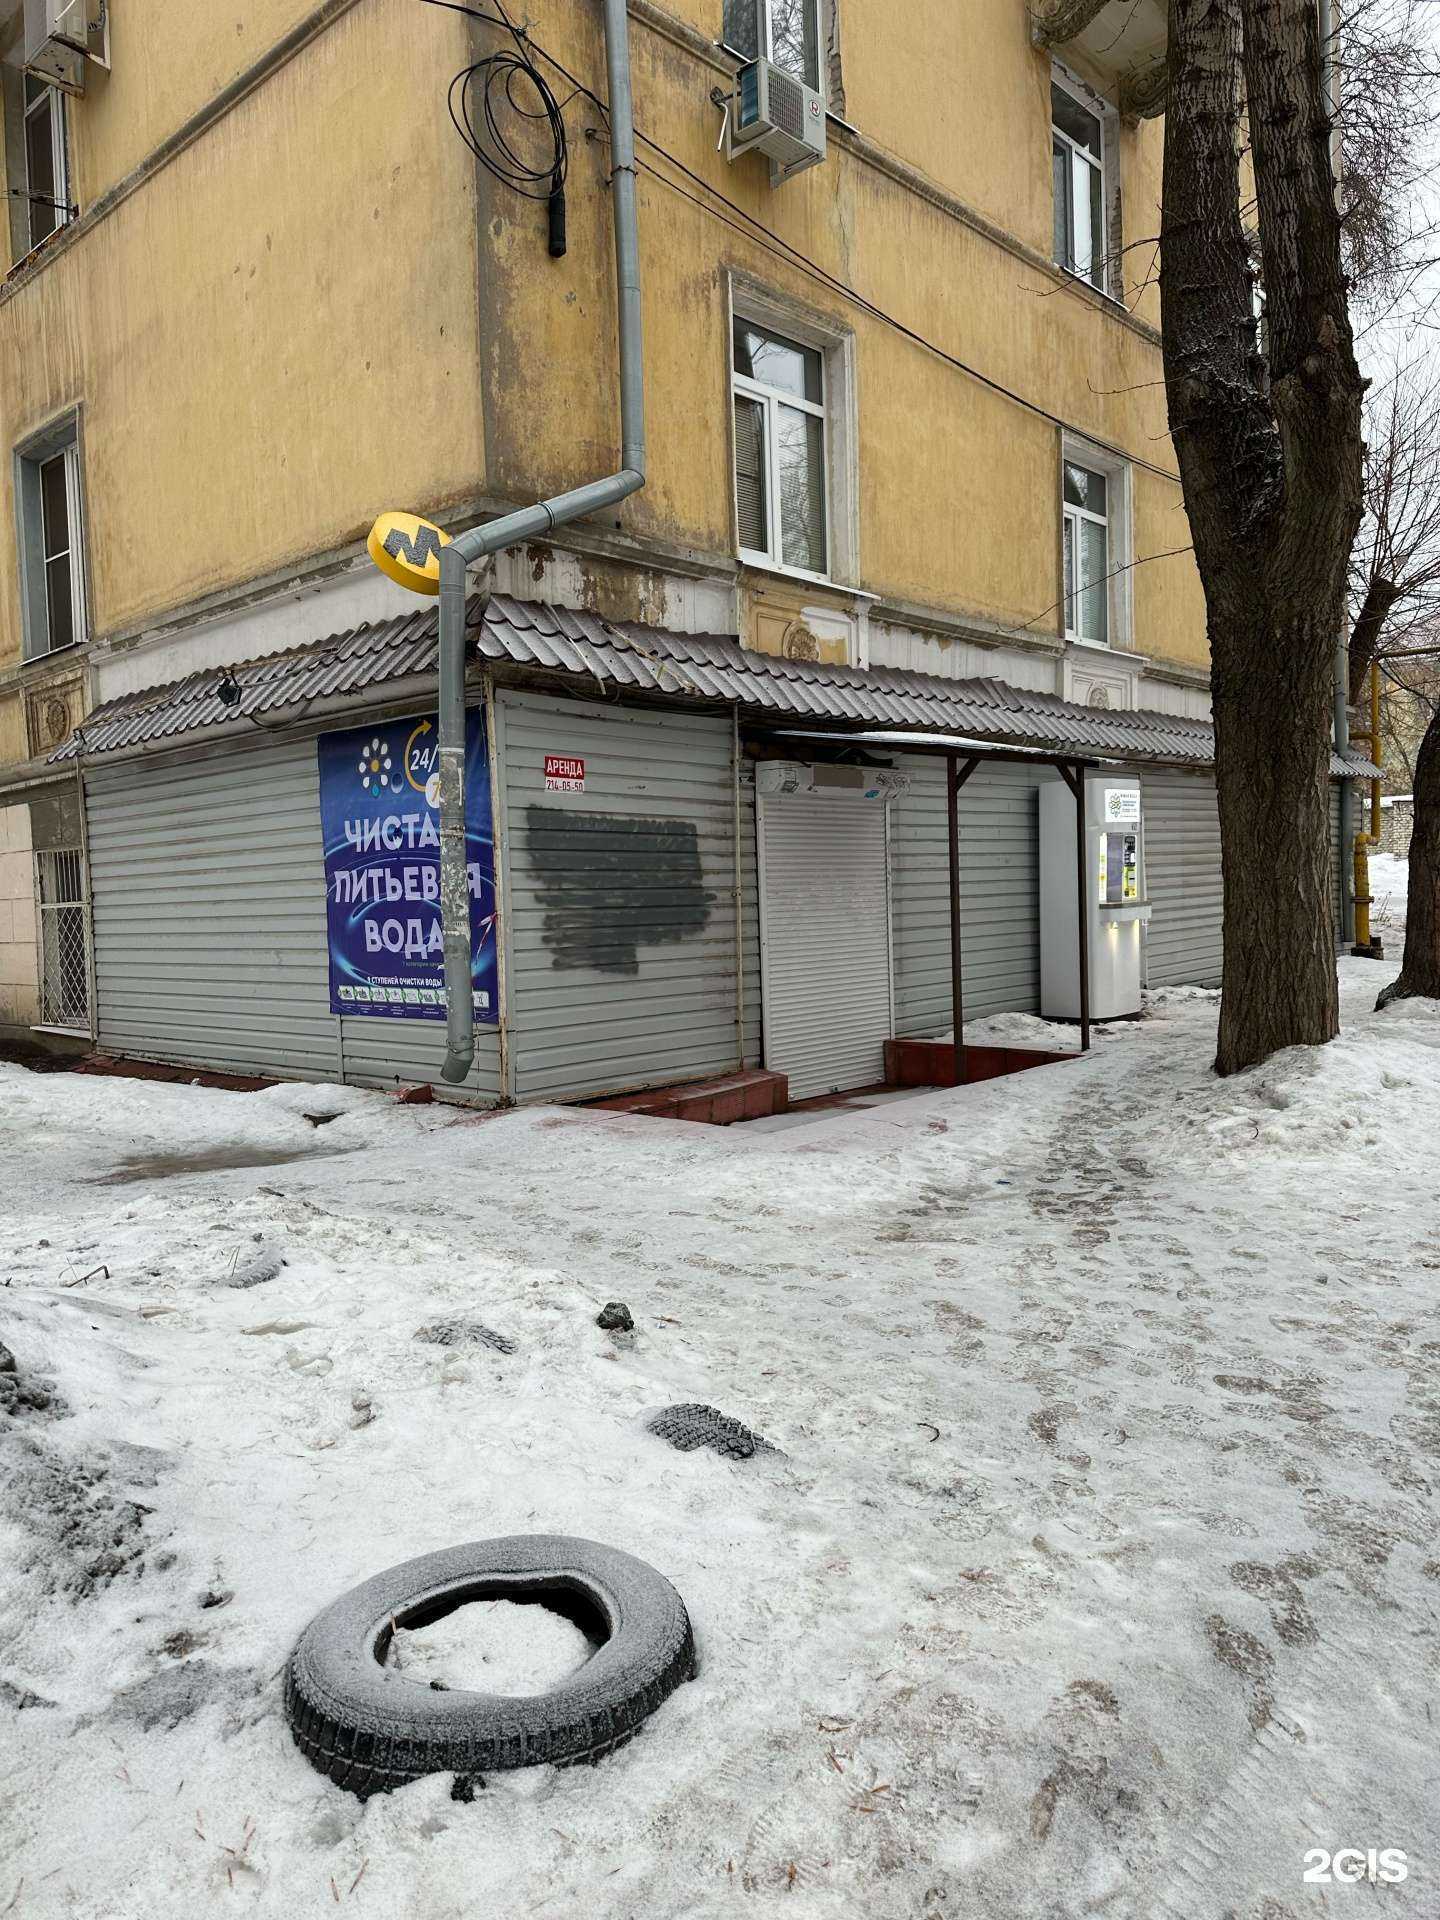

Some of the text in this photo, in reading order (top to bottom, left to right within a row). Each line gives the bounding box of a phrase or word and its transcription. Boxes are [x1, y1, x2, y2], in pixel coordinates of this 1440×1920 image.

[547, 759, 583, 777] АРЕНДА
[344, 811, 440, 853] ЧИСТА
[334, 862, 482, 903] ПИТЬЕВЯ
[364, 917, 444, 960] ВОДА
[371, 975, 399, 985] СТУПЕНЕЙ
[399, 977, 425, 986] ОЧИСТКИ
[425, 978, 443, 988] ВОДЫ
